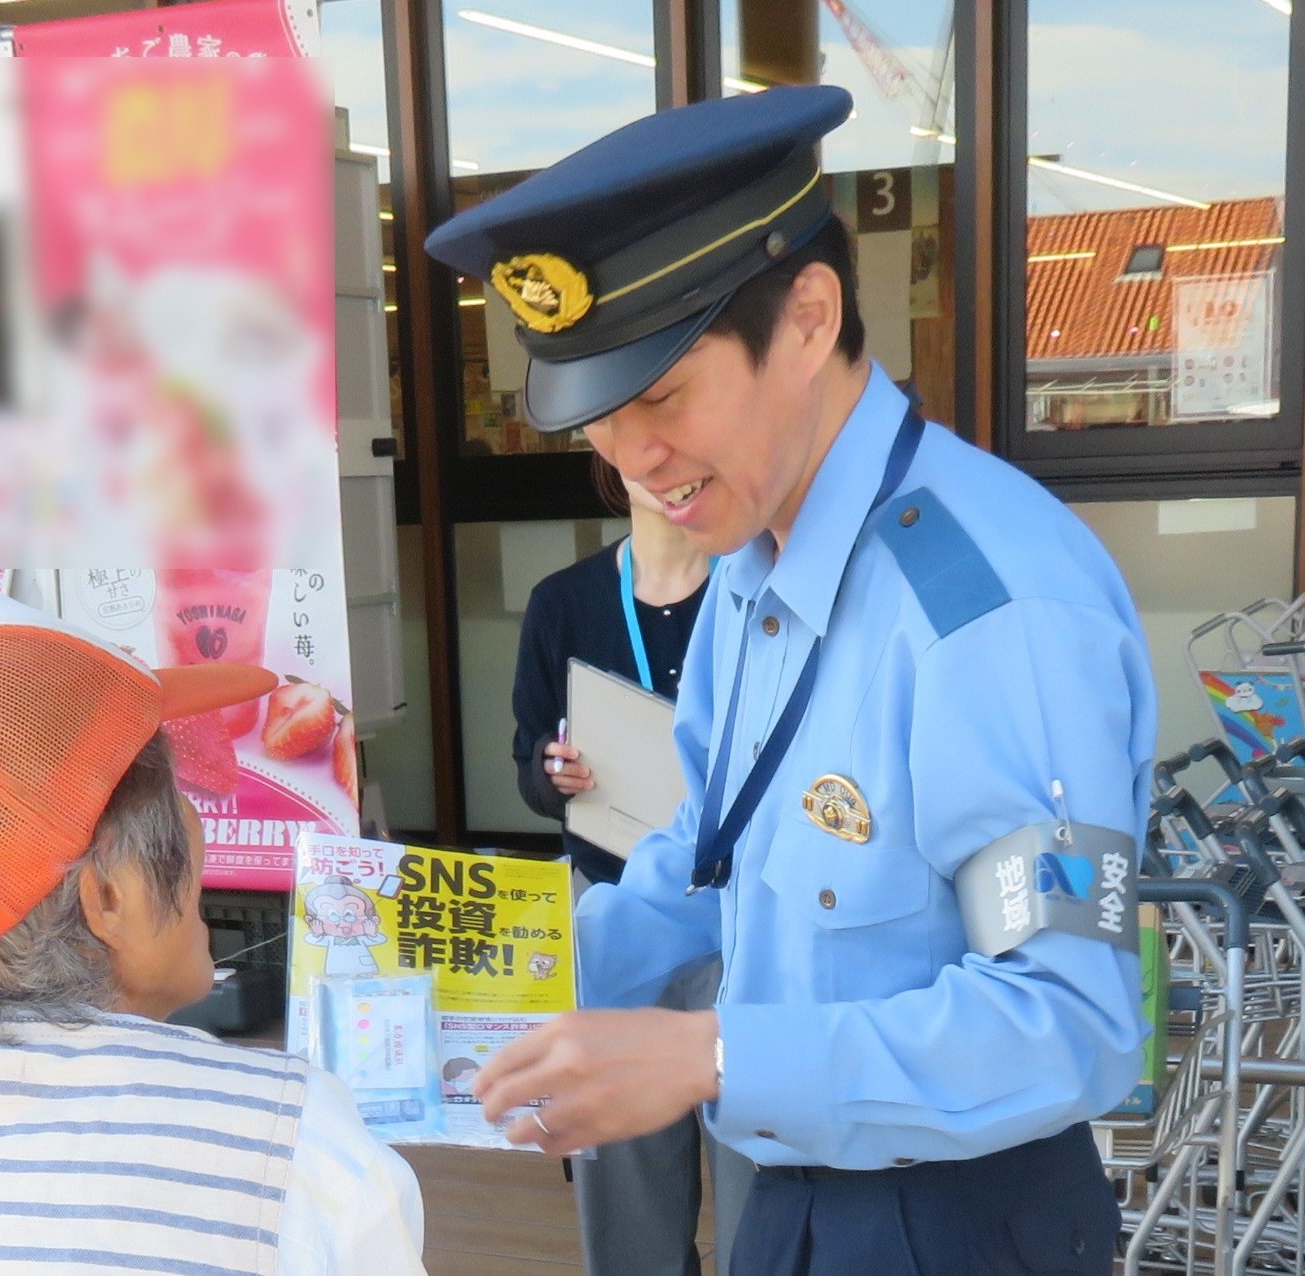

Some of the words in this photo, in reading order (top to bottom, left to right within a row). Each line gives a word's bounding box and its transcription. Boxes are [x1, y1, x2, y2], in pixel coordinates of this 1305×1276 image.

[872, 171, 895, 216] 3
[309, 844, 384, 859] 手口を知って
[310, 858, 385, 877] 防ごう!
[398, 854, 497, 899] SNS
[497, 888, 557, 904] を使って
[996, 854, 1031, 932] 地域
[1097, 851, 1129, 934] 安全
[397, 893, 497, 939] 投資
[499, 926, 563, 941] を勧める
[397, 931, 515, 977] 詐欺!
